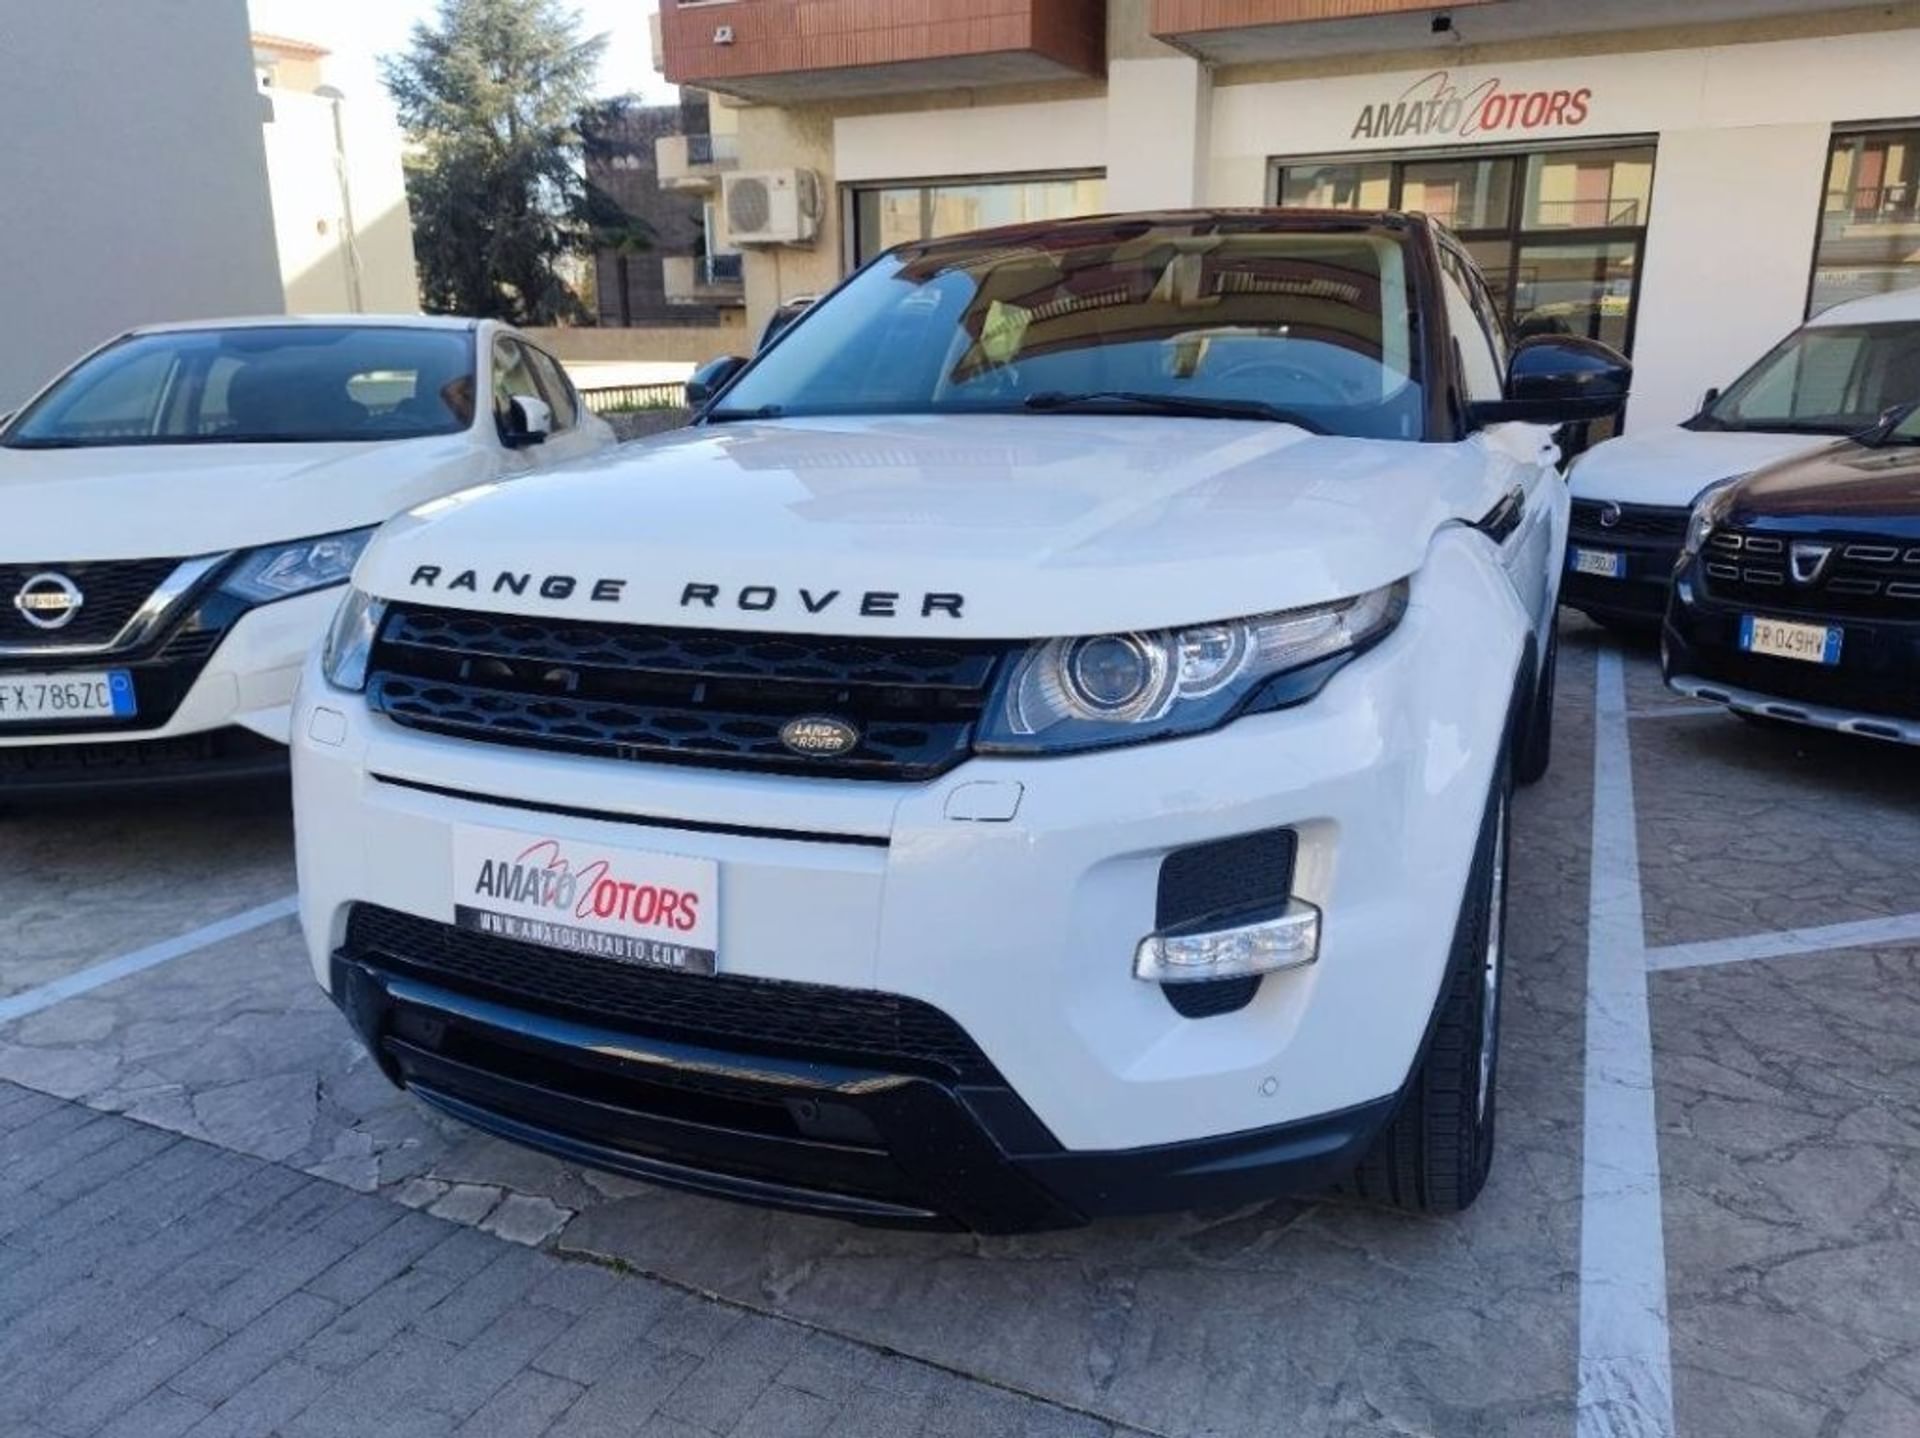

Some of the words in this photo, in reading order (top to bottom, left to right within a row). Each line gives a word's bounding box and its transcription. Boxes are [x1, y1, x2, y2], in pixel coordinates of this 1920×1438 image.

[1352, 100, 1462, 138] AMATO
[410, 565, 628, 602] RANGE
[680, 582, 965, 618] ROVER
[798, 736, 844, 749] ROVER
[475, 859, 577, 910] AMATO
